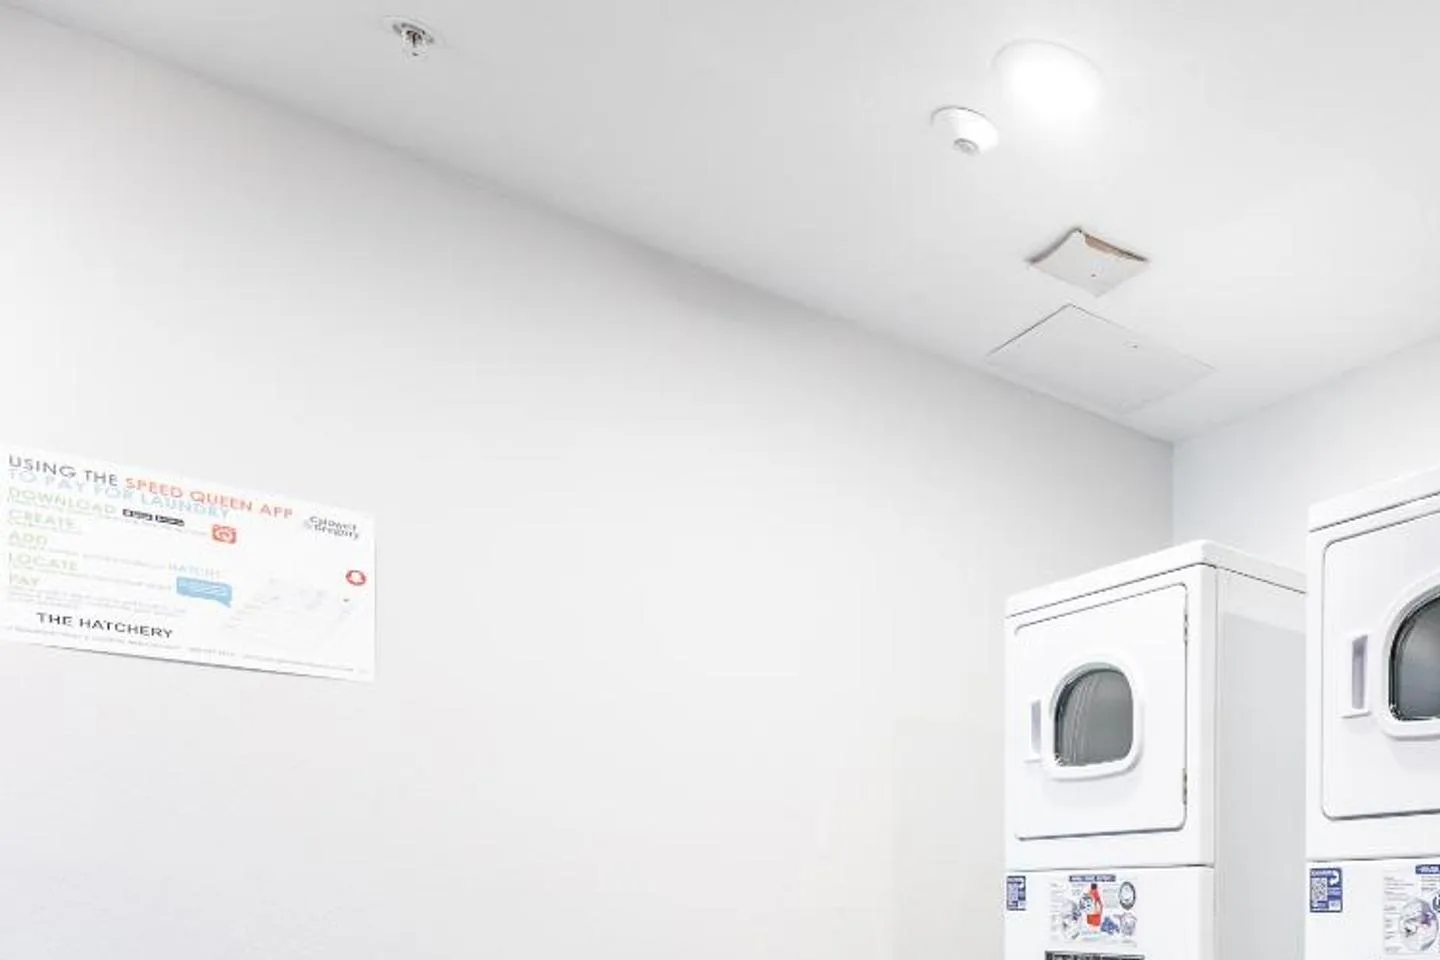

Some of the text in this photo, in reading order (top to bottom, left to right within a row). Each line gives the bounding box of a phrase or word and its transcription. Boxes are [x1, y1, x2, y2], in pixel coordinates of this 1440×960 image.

[8, 453, 293, 519] USING THE SPEED QUEEN APP
[8, 468, 37, 483] TO
[45, 474, 85, 492] PAY
[141, 494, 231, 518] LAUNDRY
[8, 486, 117, 514] DOWNLOAD
[35, 611, 74, 629] THE
[78, 617, 174, 639] HATCHERY
